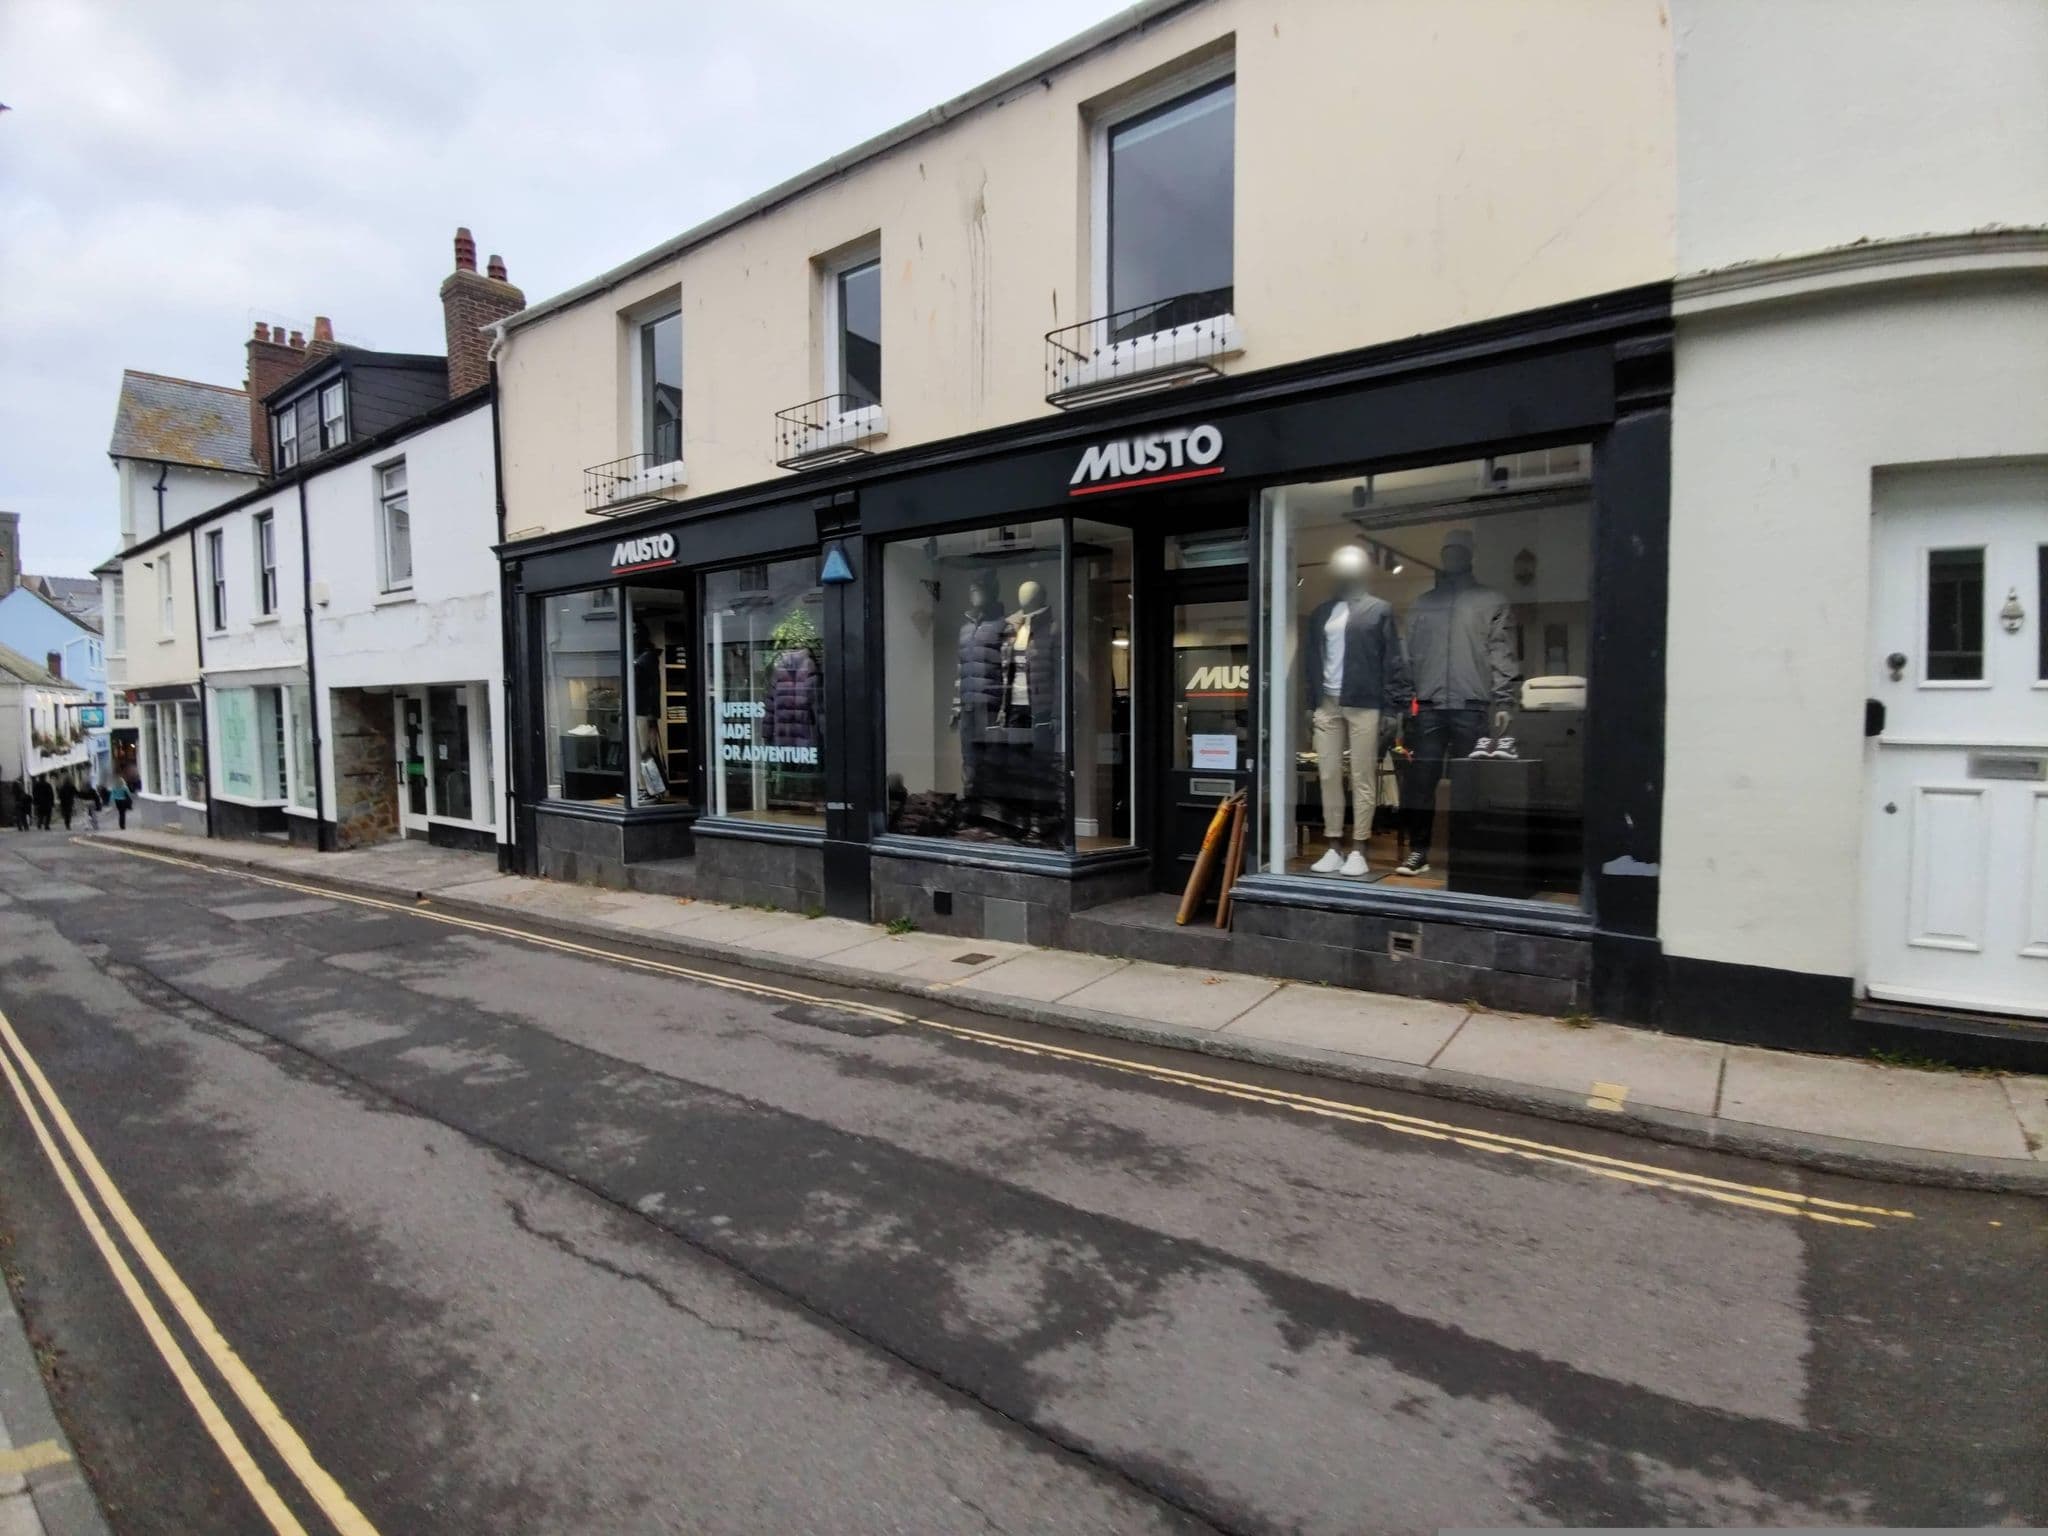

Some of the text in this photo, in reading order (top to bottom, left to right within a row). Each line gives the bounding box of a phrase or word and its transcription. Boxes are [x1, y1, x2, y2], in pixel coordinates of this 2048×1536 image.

[1069, 424, 1223, 485] MUSTO
[611, 532, 675, 567] MUSTO
[742, 745, 818, 764] ADVENTURE
